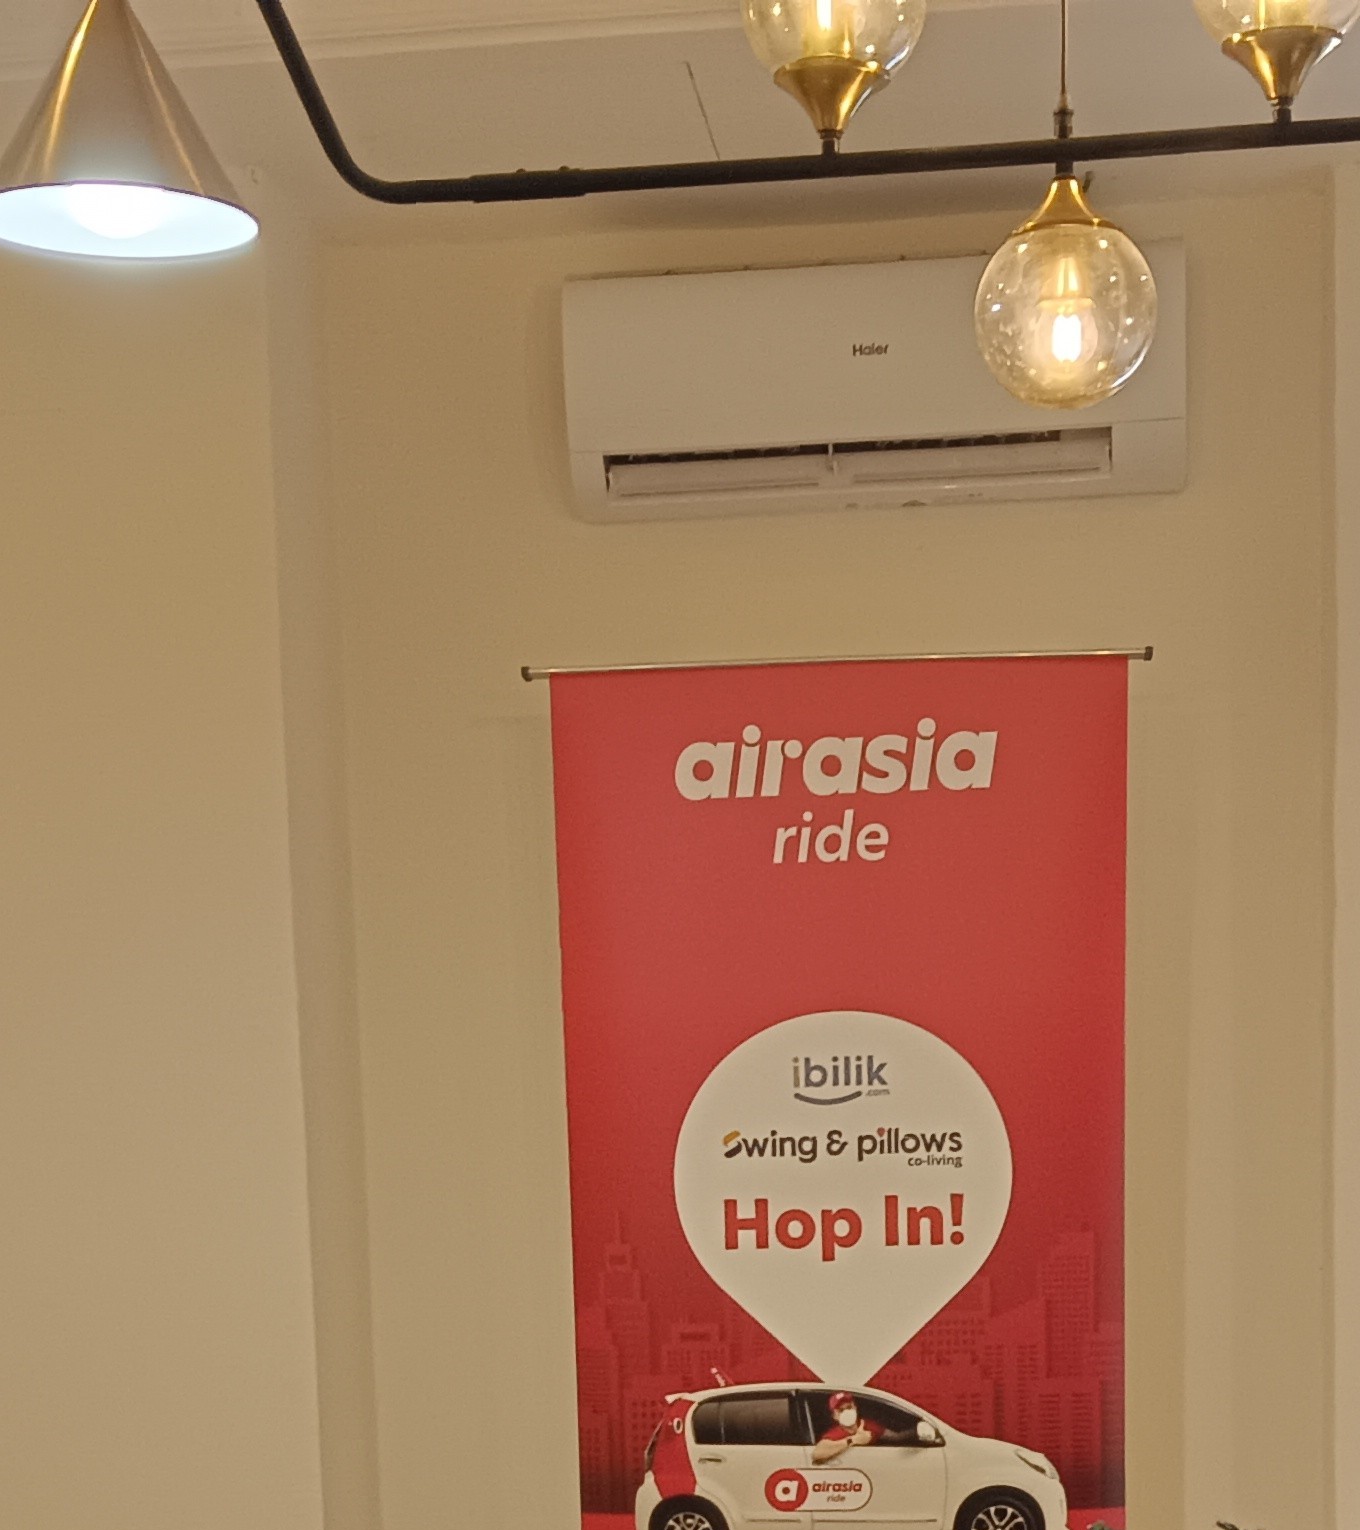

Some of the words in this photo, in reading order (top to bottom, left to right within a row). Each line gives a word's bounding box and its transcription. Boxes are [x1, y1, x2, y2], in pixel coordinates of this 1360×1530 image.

[852, 342, 889, 357] Haier
[674, 717, 998, 801] airasia
[772, 809, 889, 864] ride
[792, 1055, 888, 1088] ibilik
[826, 1129, 848, 1156] &
[857, 1127, 962, 1162] pillows
[907, 1155, 963, 1168] co-living
[724, 1198, 862, 1262] Hop
[884, 1193, 964, 1246] In!
[812, 1481, 863, 1492] airasia
[826, 1494, 846, 1502] ride
